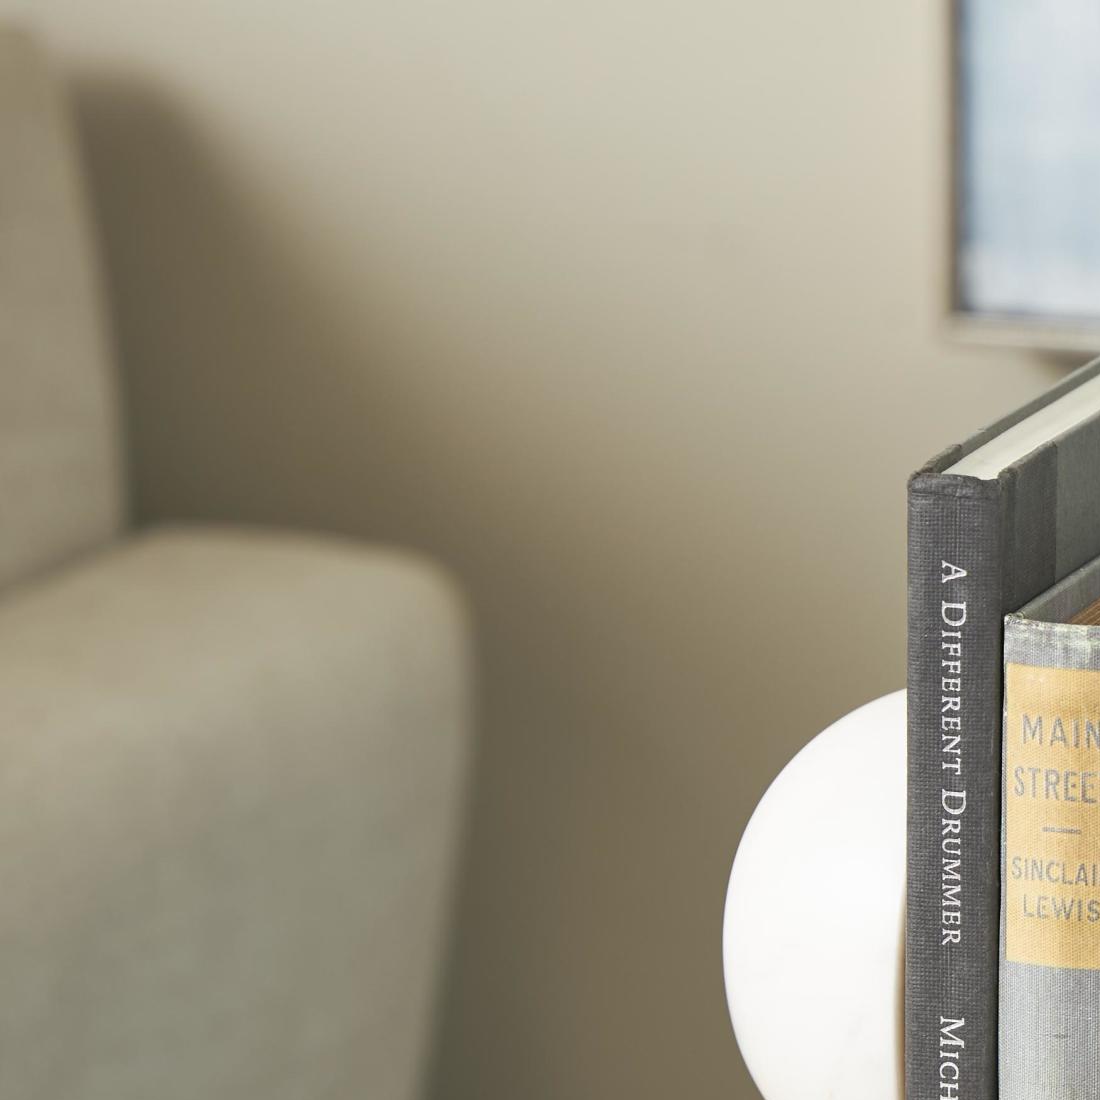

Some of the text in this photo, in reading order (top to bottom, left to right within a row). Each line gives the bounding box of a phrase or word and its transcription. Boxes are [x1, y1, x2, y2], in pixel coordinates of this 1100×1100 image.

[941, 559, 967, 946] A DIFFERENT DRUMMER
[1022, 893, 1100, 923] LEWIS
